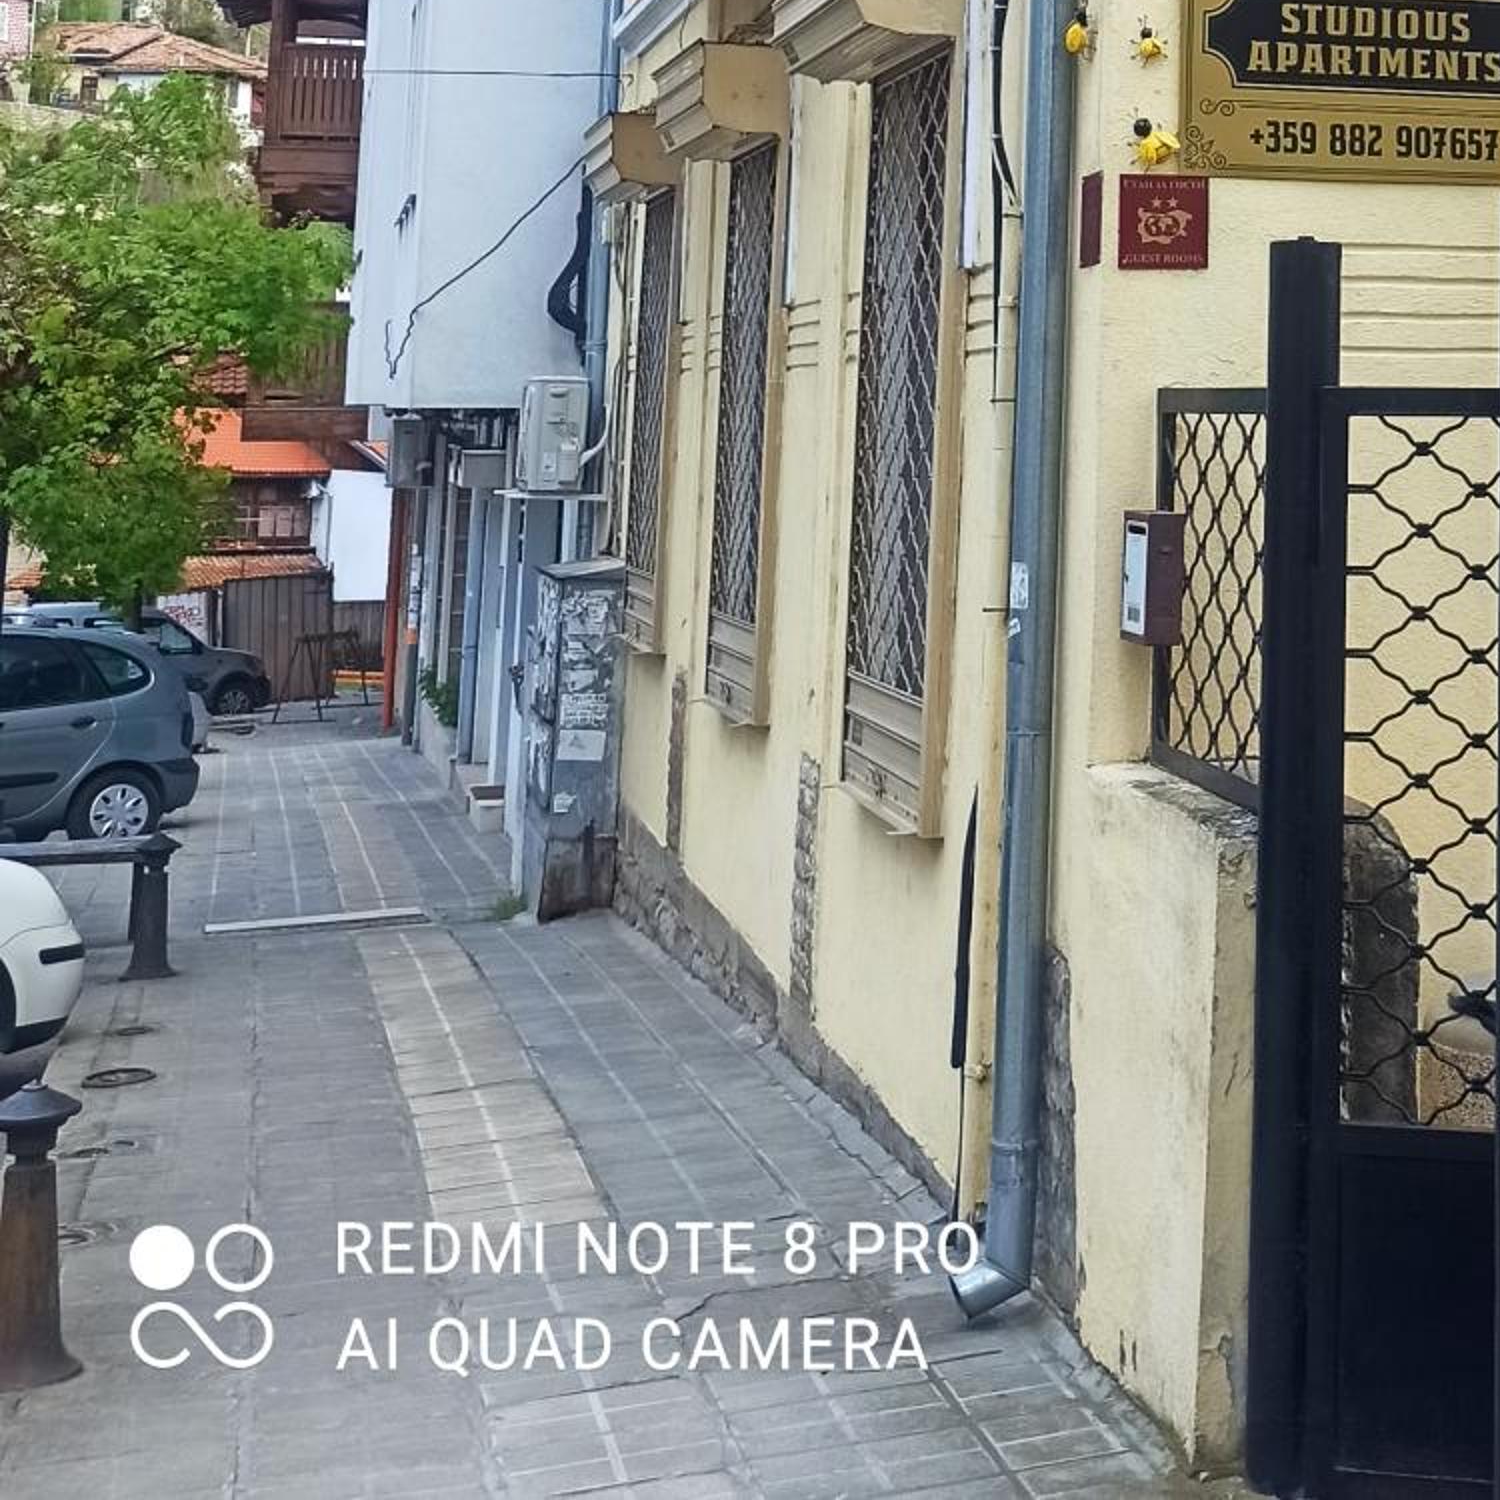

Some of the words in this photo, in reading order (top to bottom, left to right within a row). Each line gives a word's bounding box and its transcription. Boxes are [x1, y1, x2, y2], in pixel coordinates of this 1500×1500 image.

[1281, 3, 1471, 43] STUDIOUS
[1249, 121, 1317, 156] +359
[1329, 124, 1383, 158] 882
[1396, 127, 1499, 161] 907657
